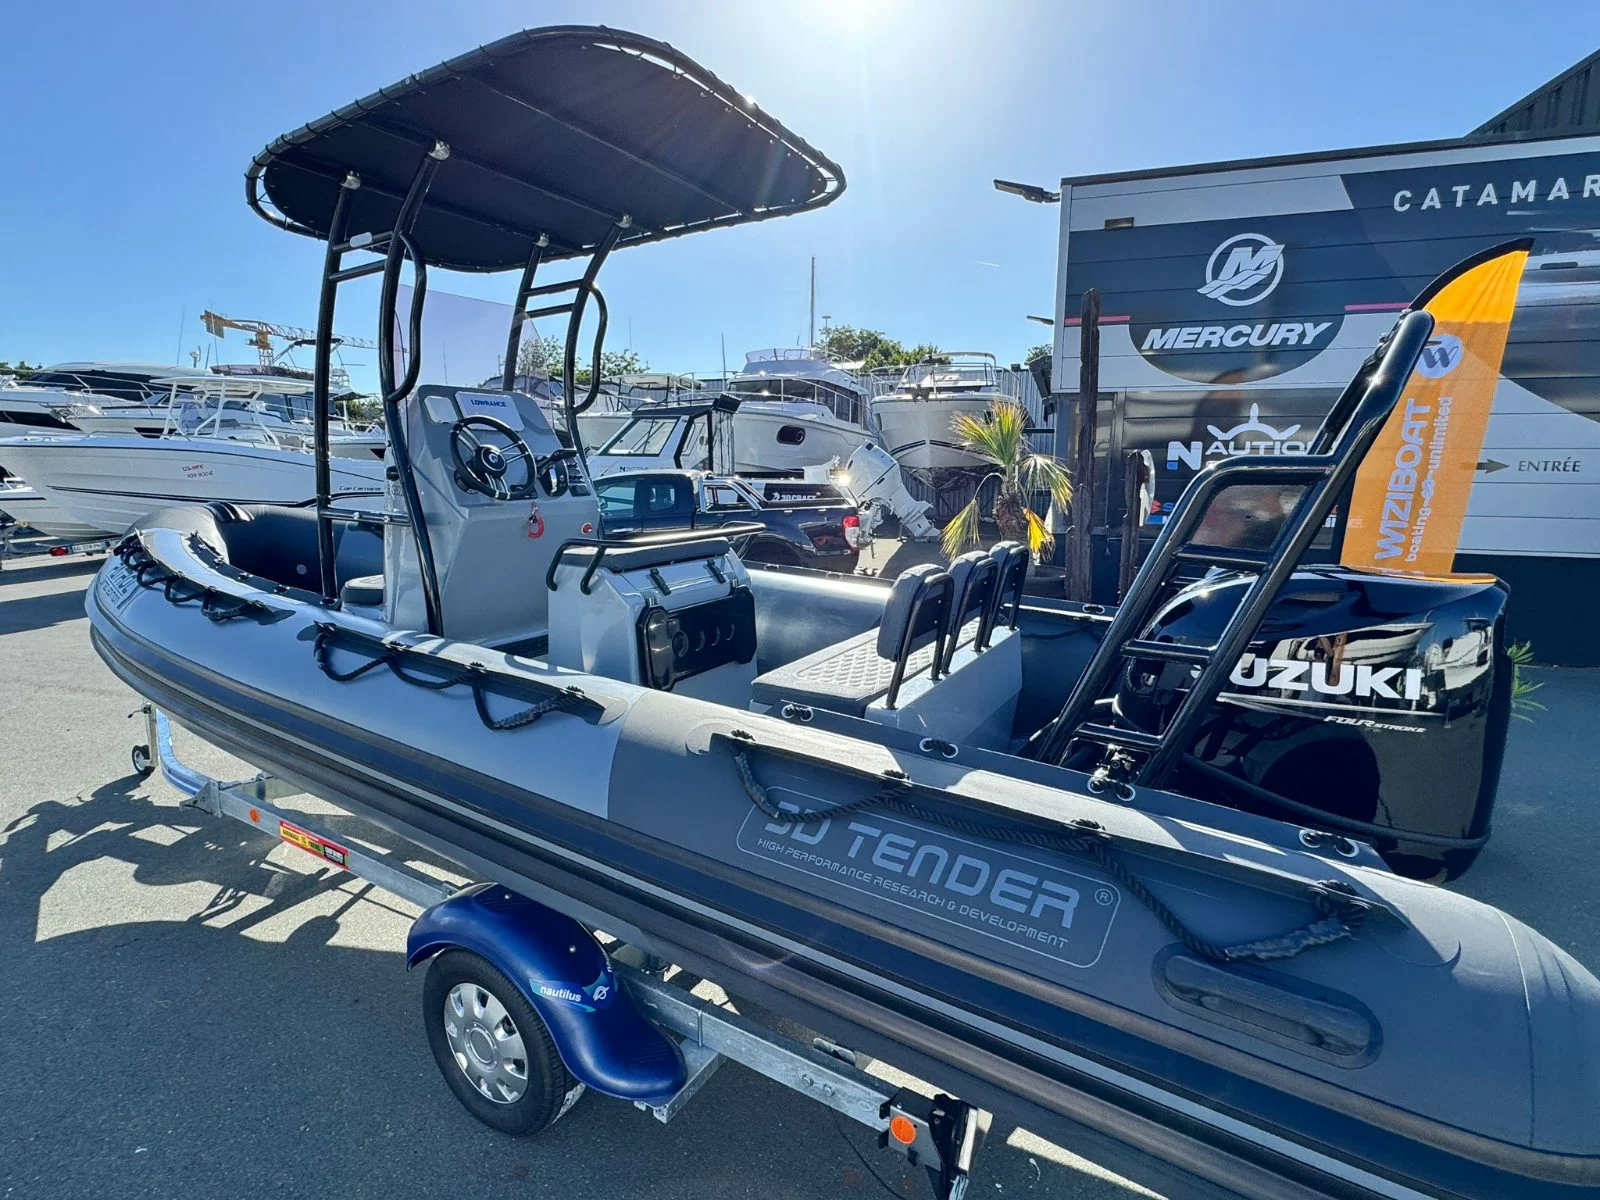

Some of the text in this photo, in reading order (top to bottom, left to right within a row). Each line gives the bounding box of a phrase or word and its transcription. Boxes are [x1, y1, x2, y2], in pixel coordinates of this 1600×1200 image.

[1141, 322, 1333, 350] MERCURY
[470, 399, 506, 407] LOWRANCE
[1374, 397, 1431, 560] WIZIBOAT
[1518, 456, 1581, 472] ENTRÉE
[1190, 653, 1422, 701] UZUKI
[757, 837, 1069, 949] HIGH PERFORMANCE RESEARCH & DEVELOPMENT
[847, 821, 1081, 929] TENDER
[540, 986, 582, 1002] nautilus
